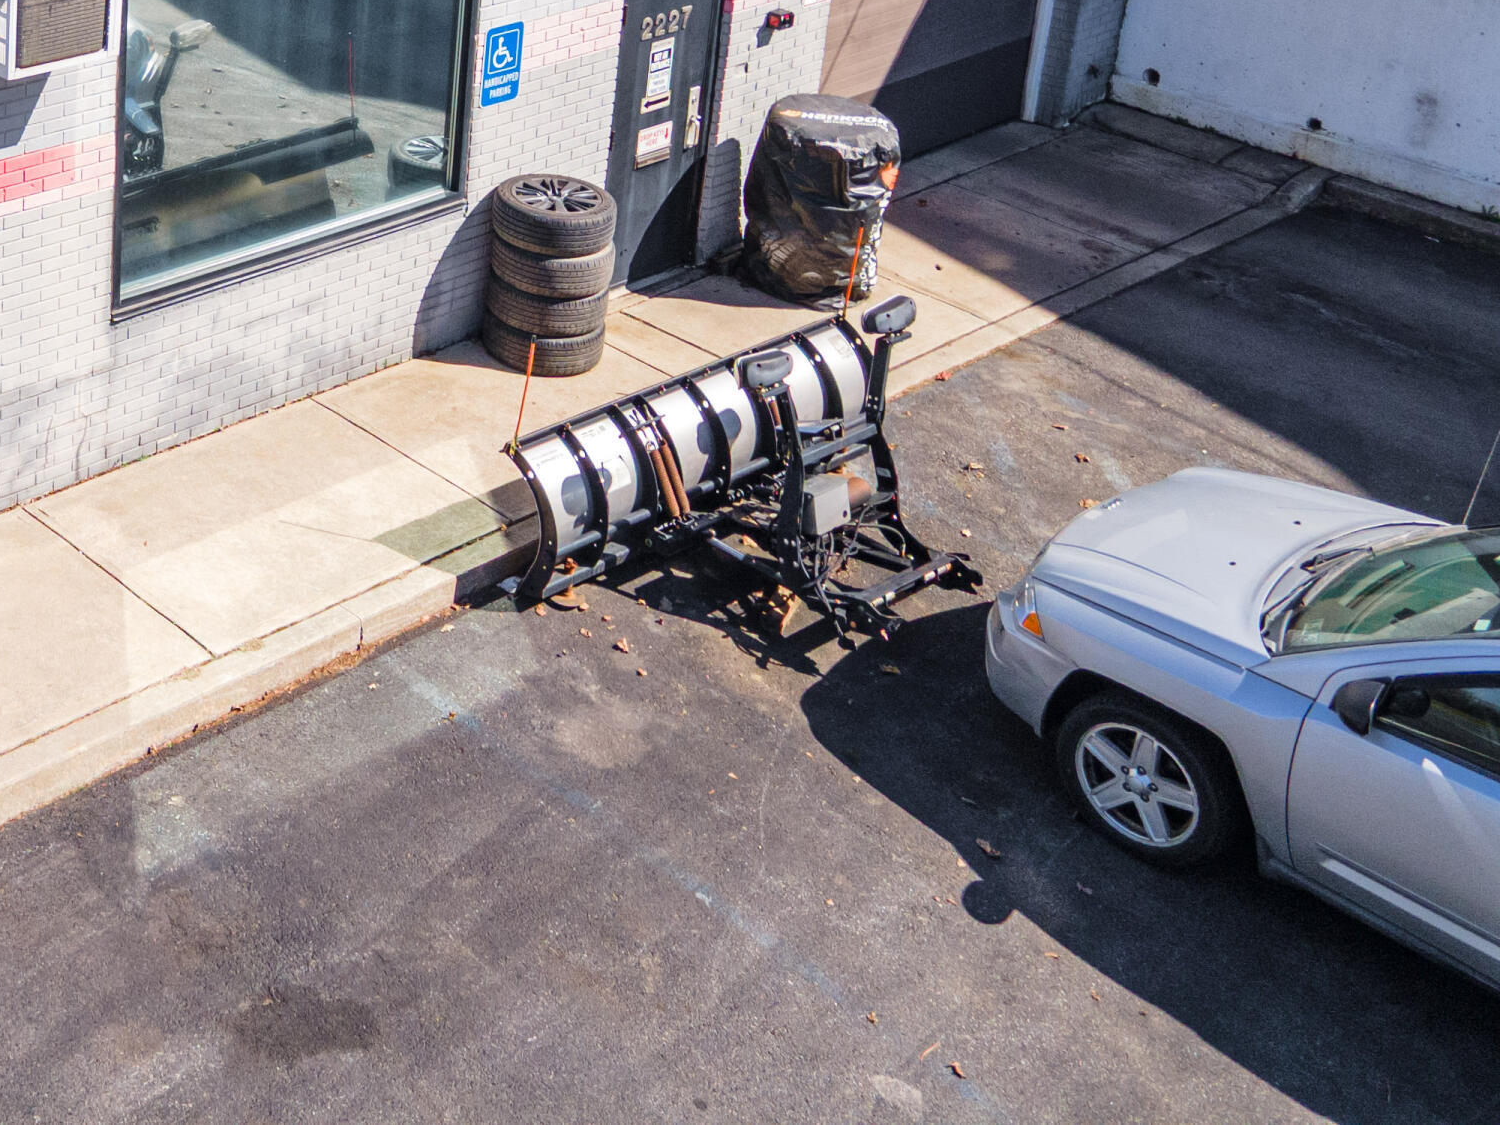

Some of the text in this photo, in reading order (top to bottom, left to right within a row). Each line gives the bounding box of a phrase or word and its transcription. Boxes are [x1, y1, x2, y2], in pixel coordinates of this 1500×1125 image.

[641, 5, 693, 41] 2227
[484, 72, 519, 89] HANDICAPPED
[489, 85, 511, 99] PARKING
